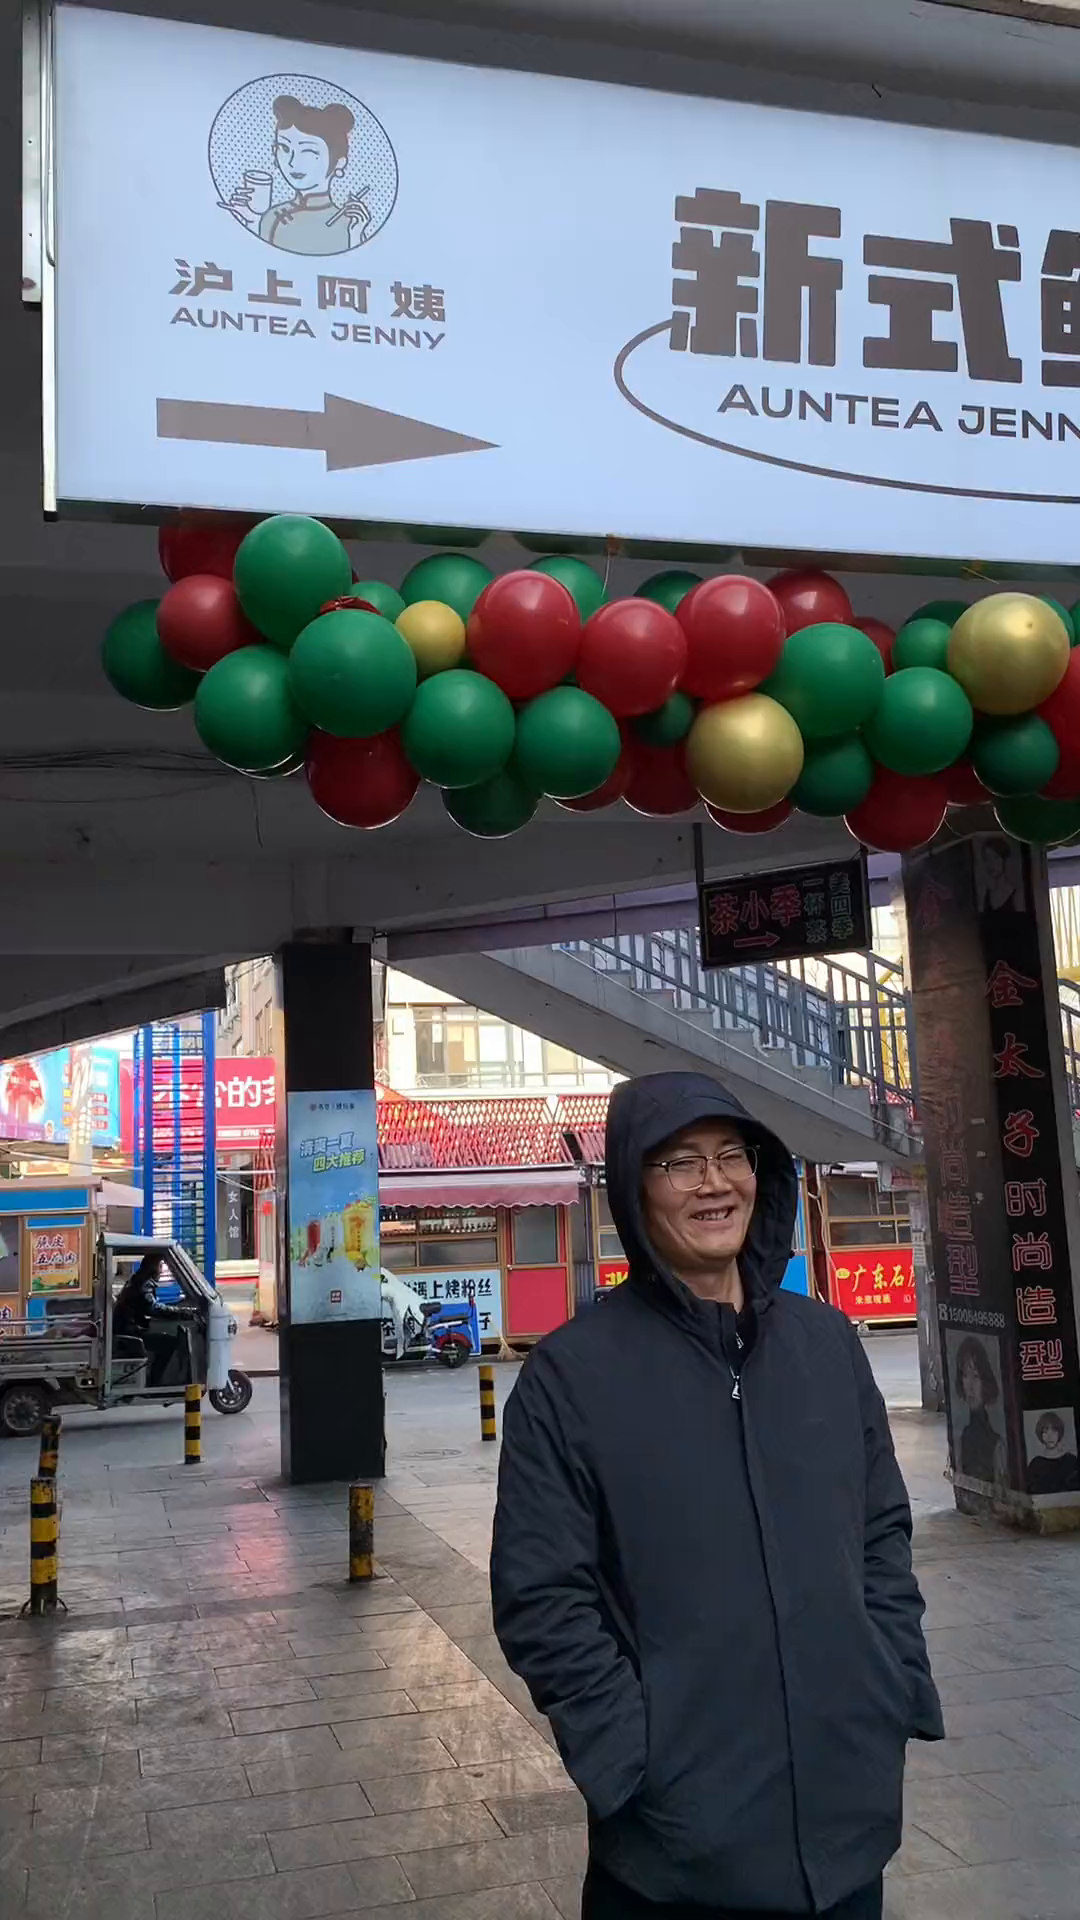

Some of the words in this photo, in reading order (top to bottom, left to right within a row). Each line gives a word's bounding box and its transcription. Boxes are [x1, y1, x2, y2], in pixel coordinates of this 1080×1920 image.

[168, 257, 447, 323] 沪上阿姨
[669, 187, 1080, 387] 新式
[169, 306, 317, 339] AUNTEA
[330, 322, 447, 351] JENNY
[716, 383, 944, 433] AUNTEA
[957, 403, 1080, 443] JENN
[709, 883, 803, 936] 茶小季
[312, 1148, 366, 1173] 四大推荐
[984, 959, 1065, 1382] 金太子时尚造型
[228, 1190, 240, 1239] 女人馆
[404, 1278, 493, 1300] 遇上烤粉丝
